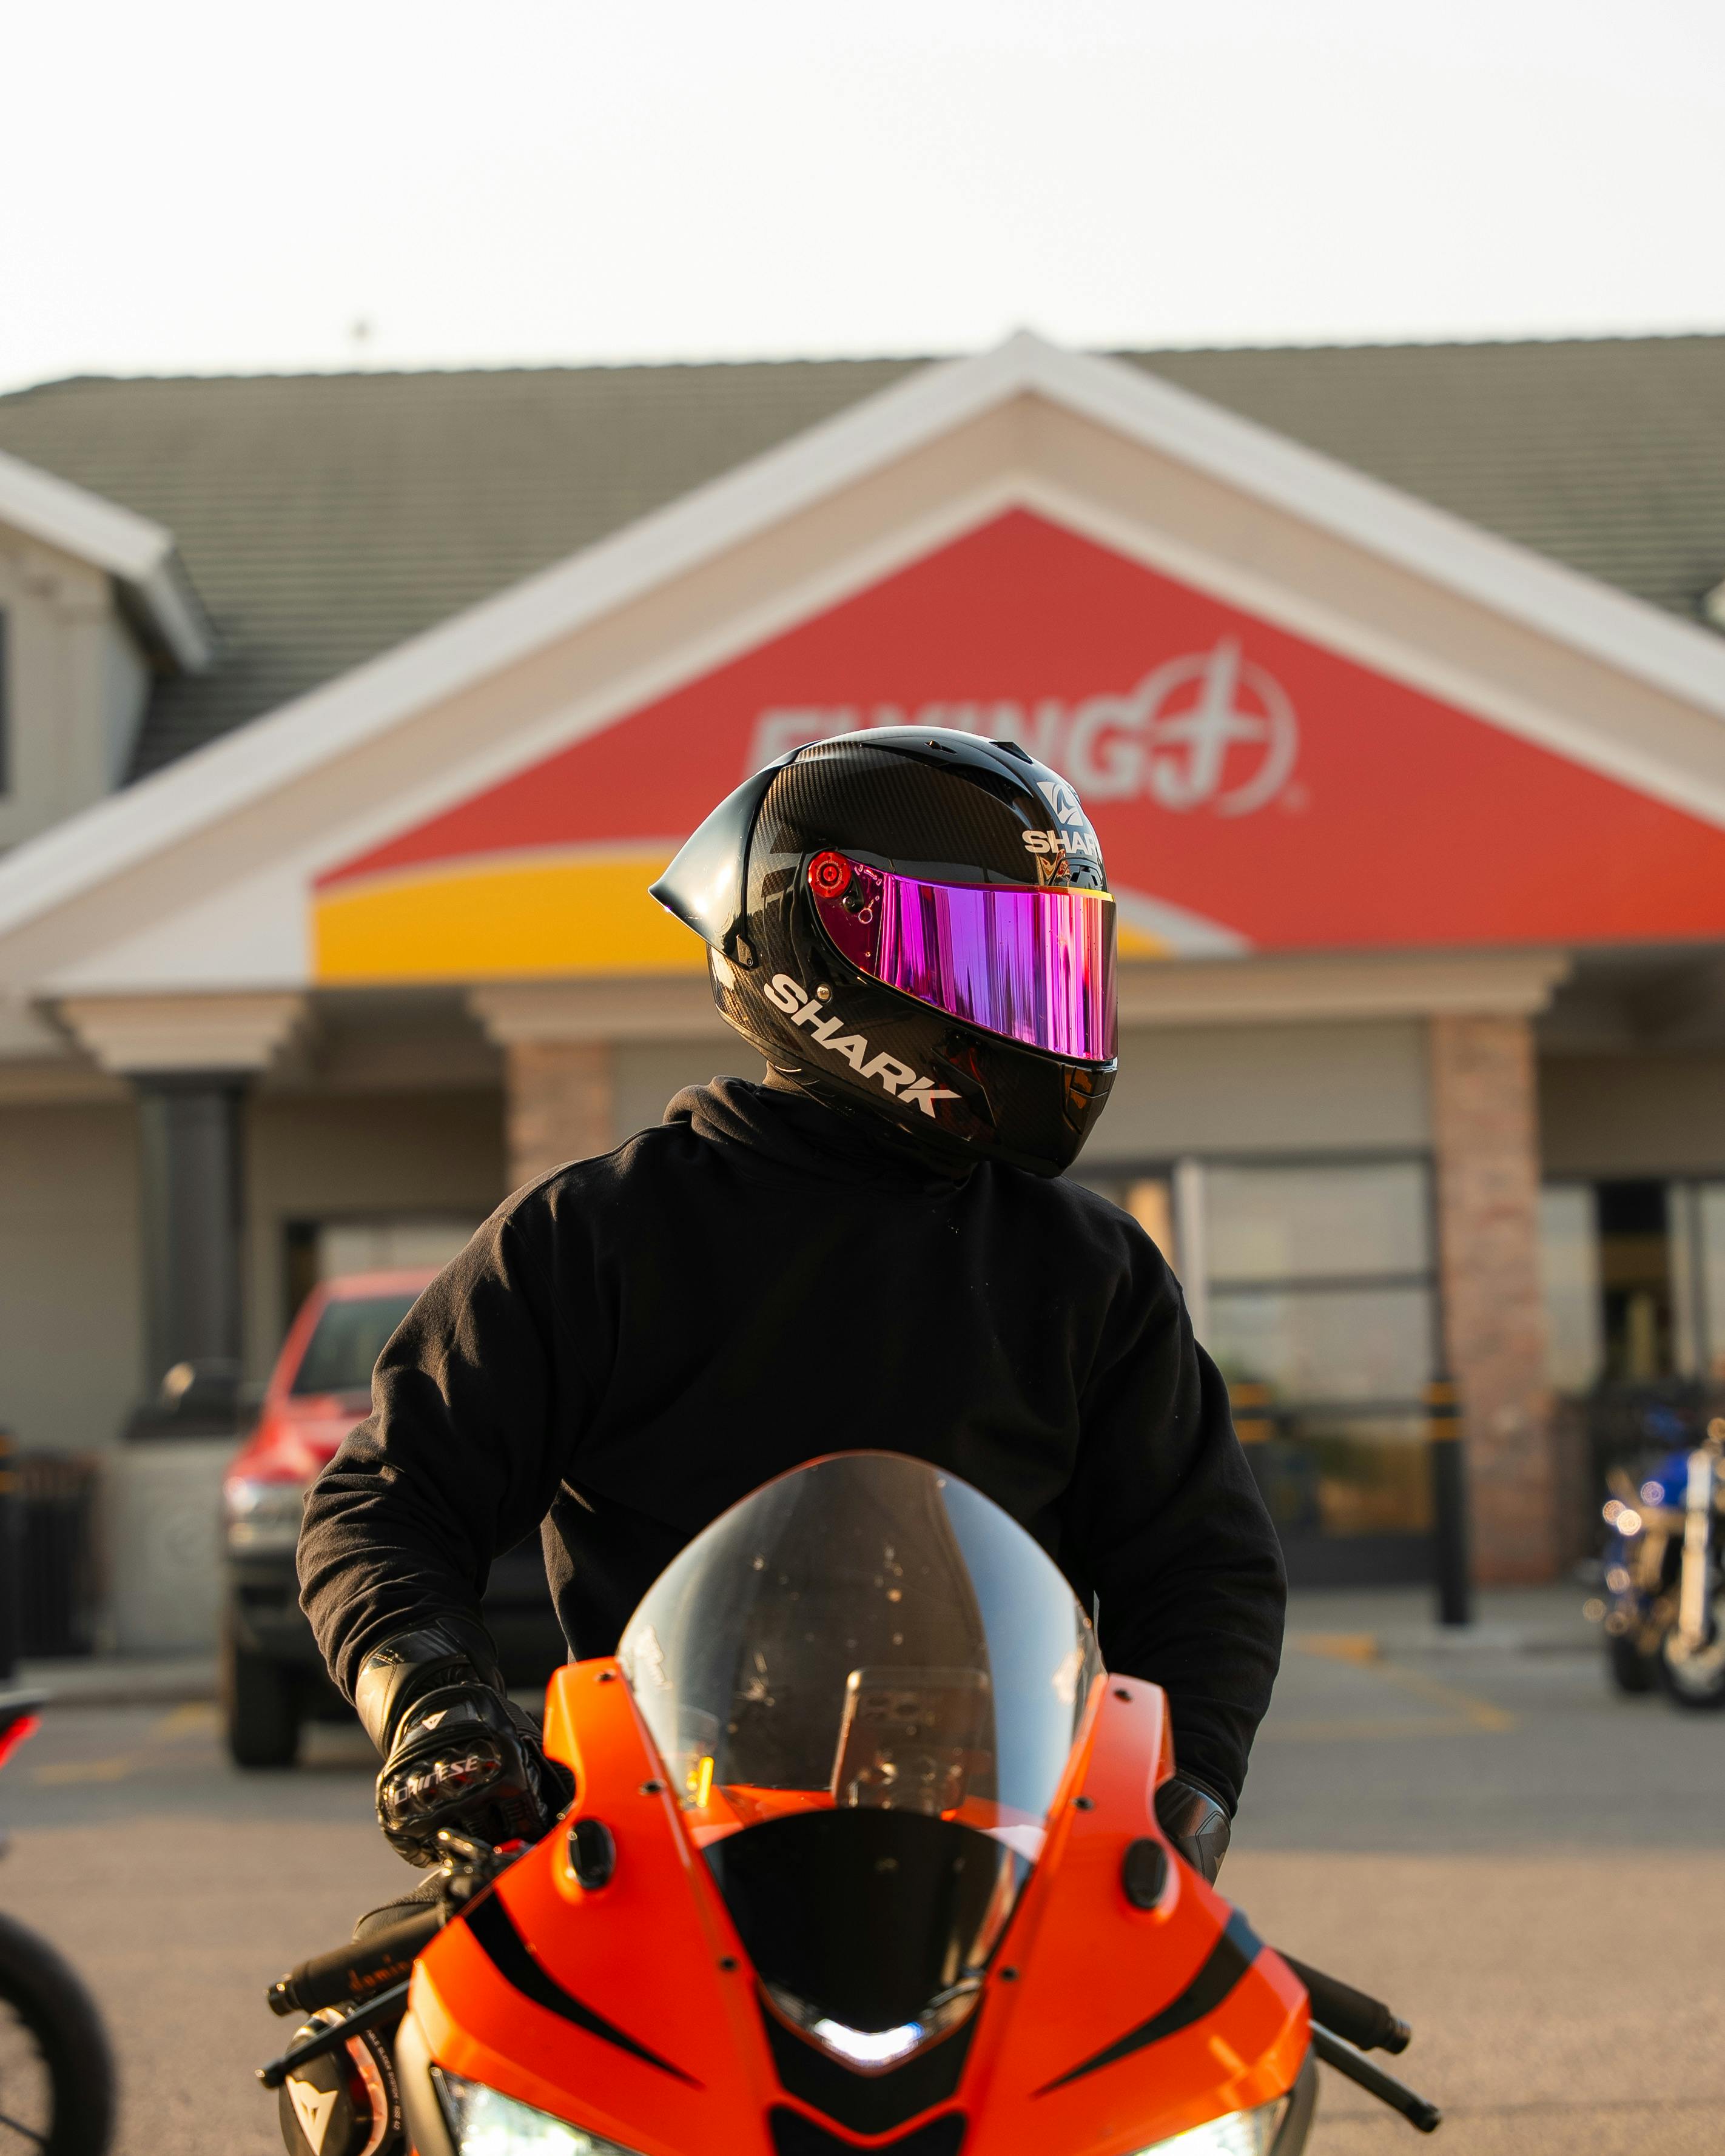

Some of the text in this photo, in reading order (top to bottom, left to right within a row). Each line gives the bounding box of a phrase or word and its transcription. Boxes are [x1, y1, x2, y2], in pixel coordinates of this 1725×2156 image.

[1022, 830, 1097, 856] SHAR
[764, 973, 962, 1118] SHARK
[348, 1954, 412, 1990] domin
